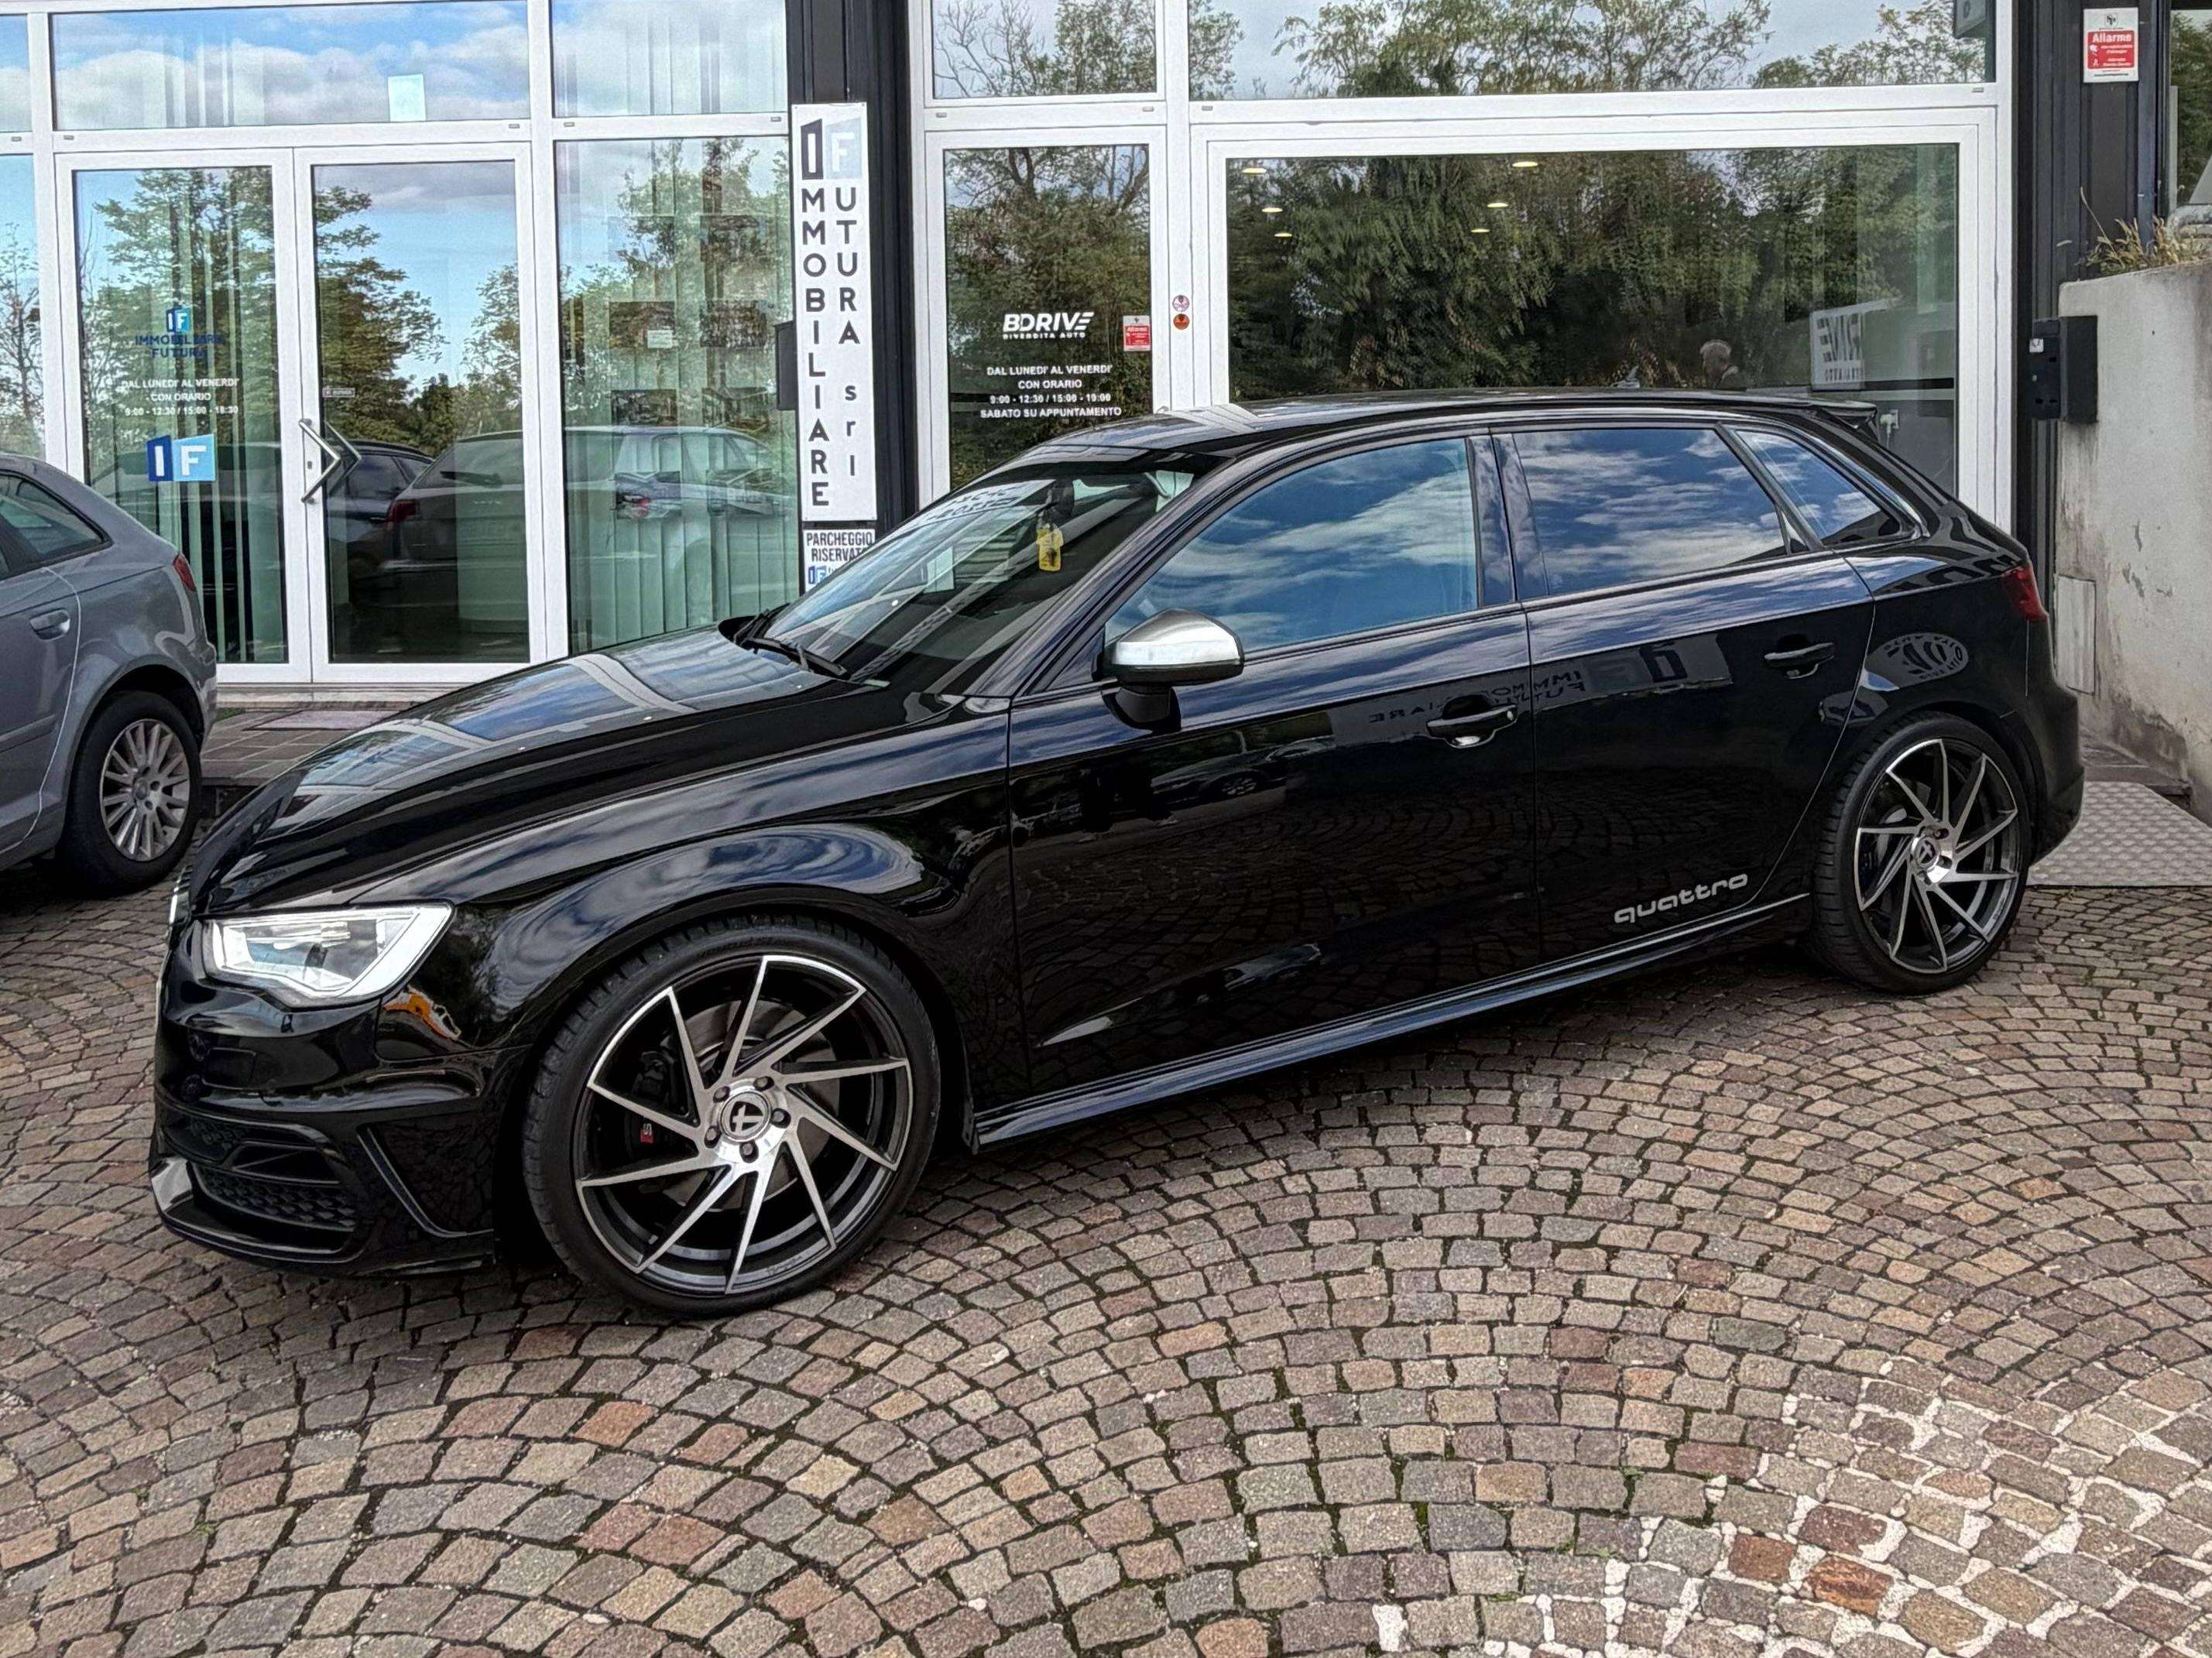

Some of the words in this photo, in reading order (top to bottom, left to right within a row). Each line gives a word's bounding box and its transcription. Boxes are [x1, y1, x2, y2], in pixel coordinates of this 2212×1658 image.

[2092, 33, 2131, 43] Allarme
[987, 367, 1008, 375] DAL
[1051, 366, 1064, 375] AL
[122, 379, 141, 389] DAL
[181, 379, 194, 388] AL
[1018, 380, 1040, 389] CON
[1043, 379, 1082, 389] ORARIO
[151, 392, 172, 402] CON
[174, 392, 211, 401] ORARIO
[980, 409, 1020, 419] SABATO
[1024, 409, 1037, 418] SU
[1040, 407, 1122, 417] APPUNTAMENTO
[153, 442, 210, 478] IF
[806, 532, 873, 546] PARCHEGGIO
[811, 547, 862, 562] RISERVAT
[1614, 873, 1748, 923] quattro
